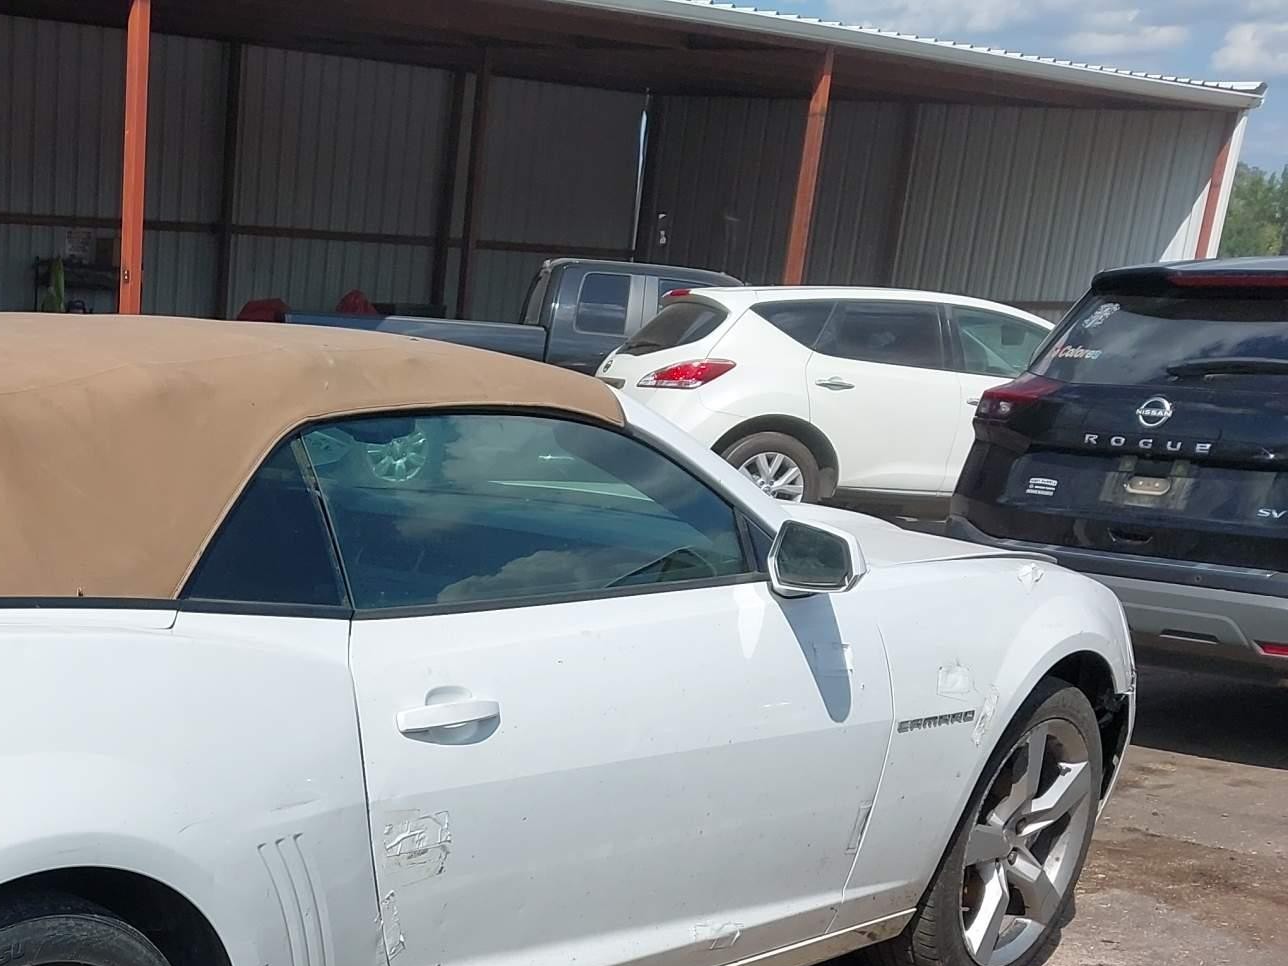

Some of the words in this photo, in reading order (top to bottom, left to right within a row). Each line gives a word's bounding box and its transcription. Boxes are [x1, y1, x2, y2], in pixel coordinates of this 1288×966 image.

[1135, 408, 1173, 417] NISSAN
[1084, 433, 1212, 453] ROGUE
[1256, 508, 1287, 519] SV
[897, 710, 976, 733] CAMARO
